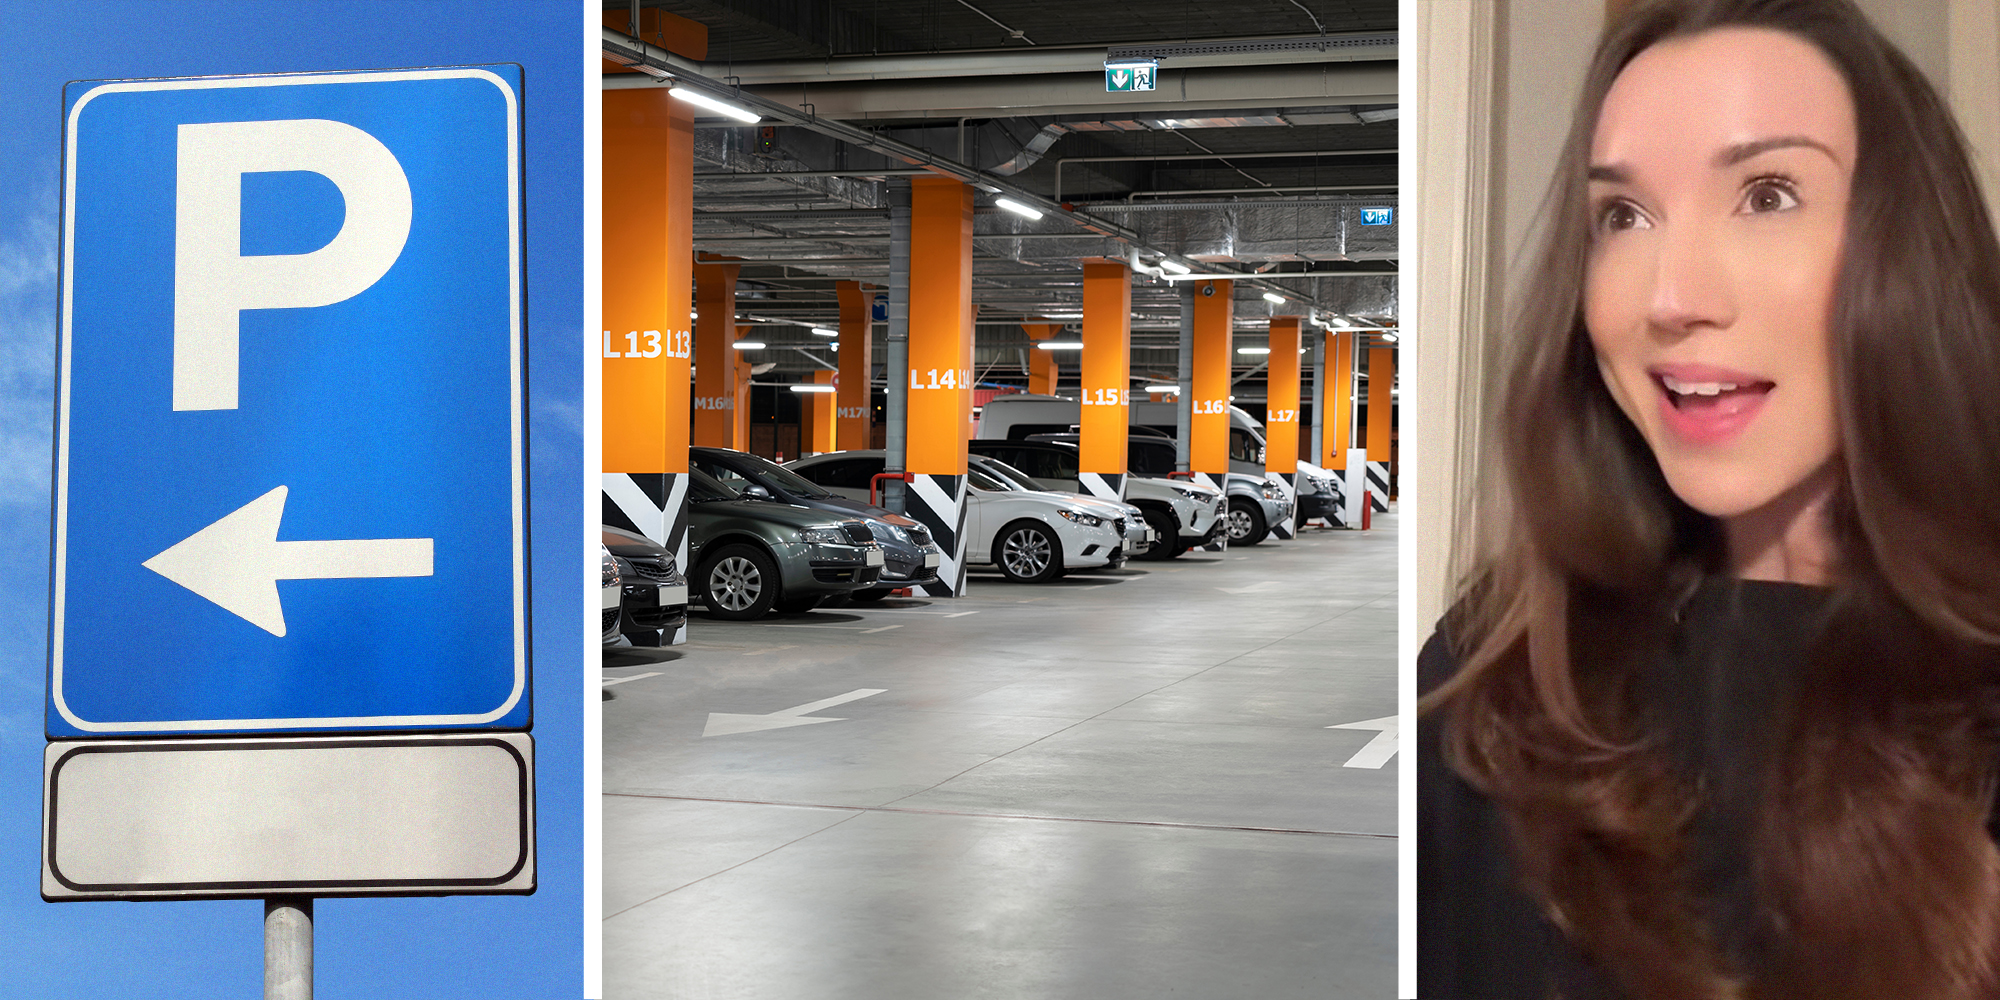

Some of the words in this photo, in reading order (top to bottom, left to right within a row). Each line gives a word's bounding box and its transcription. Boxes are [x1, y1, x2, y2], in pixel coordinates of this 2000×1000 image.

[173, 119, 412, 411] P
[603, 330, 662, 358] L13
[667, 329, 690, 358] L13
[911, 369, 956, 389] L14
[695, 397, 724, 410] M16
[1082, 388, 1118, 405] L15
[837, 407, 863, 418] M17
[1193, 400, 1223, 414] L16
[1268, 409, 1294, 422] L17
